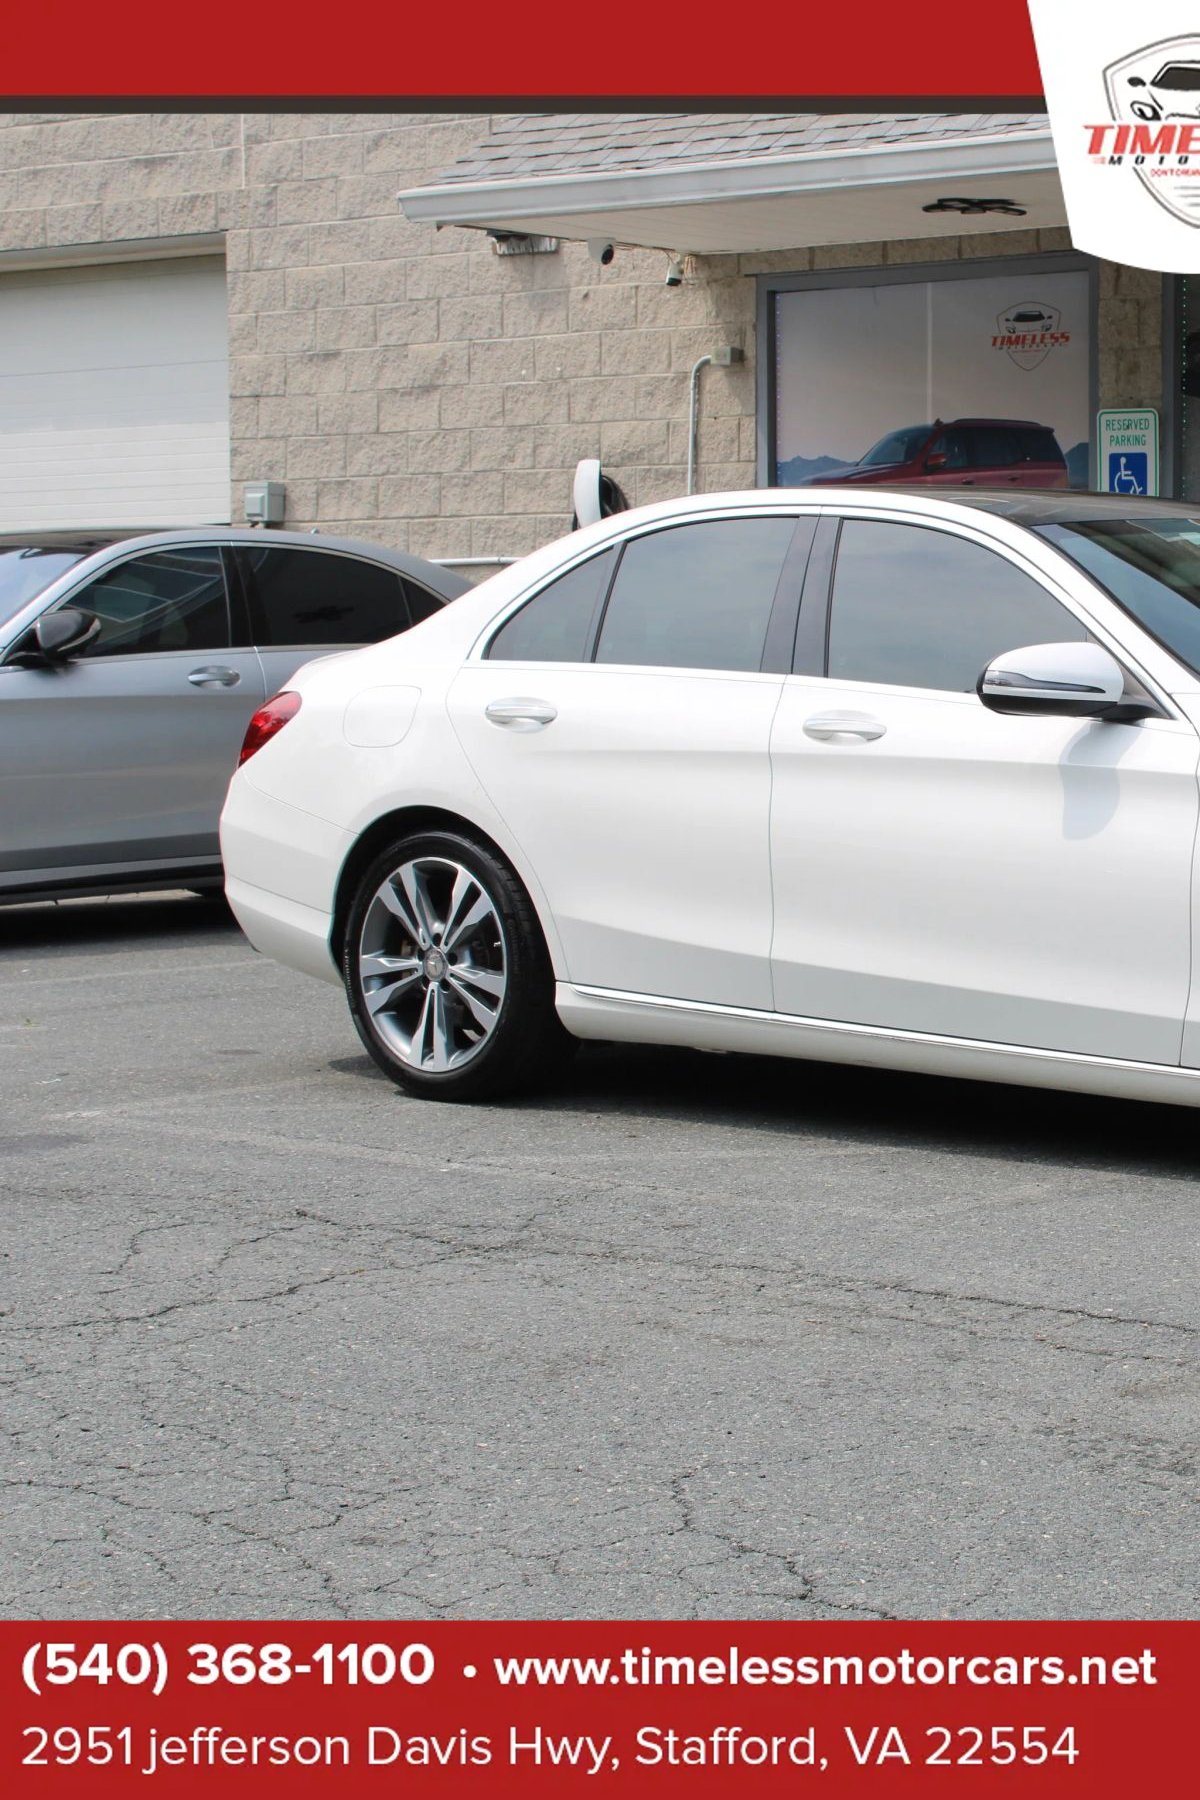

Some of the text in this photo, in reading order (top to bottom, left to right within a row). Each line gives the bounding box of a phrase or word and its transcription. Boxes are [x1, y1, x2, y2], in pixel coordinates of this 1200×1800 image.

[991, 331, 1071, 347] TIMELESS
[1105, 418, 1150, 431] RESERVED
[1109, 434, 1147, 447] PARKING
